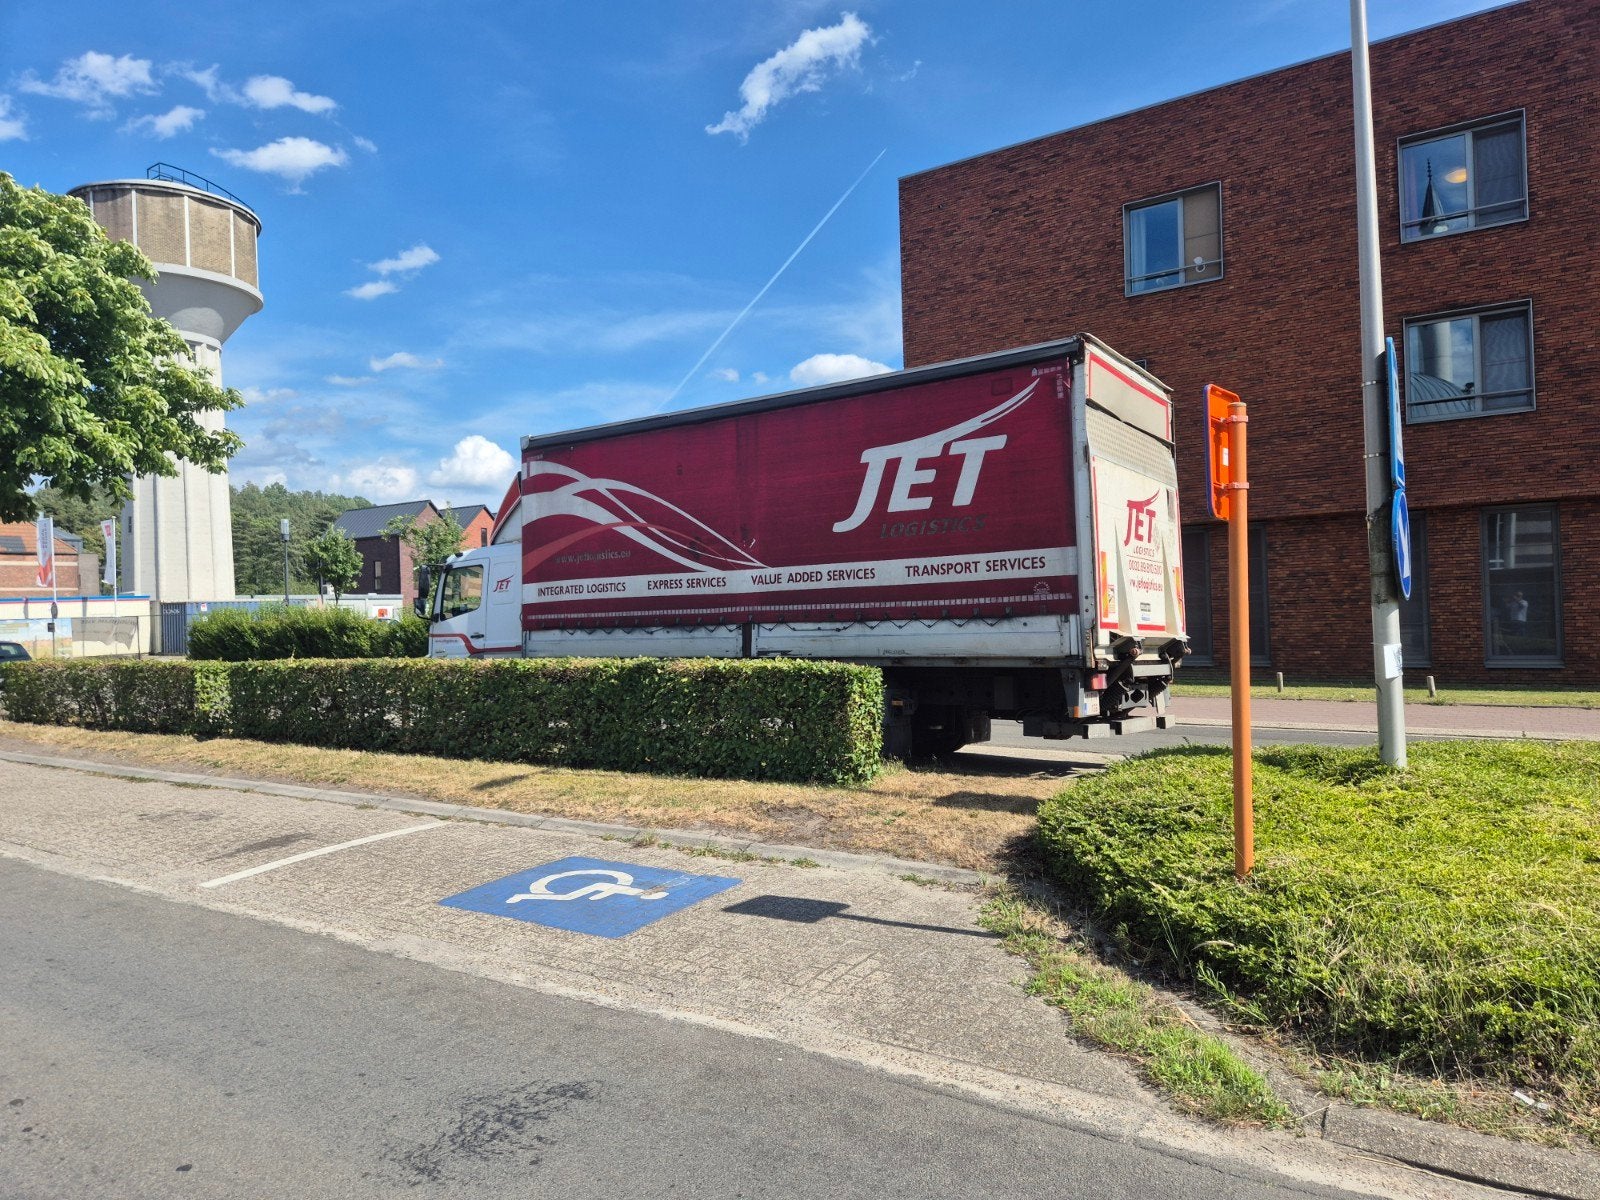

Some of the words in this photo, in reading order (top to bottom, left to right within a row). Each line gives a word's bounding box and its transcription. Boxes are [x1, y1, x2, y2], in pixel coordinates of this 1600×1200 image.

[832, 434, 1008, 533] JET
[880, 514, 988, 539] LOGISTICS
[1124, 498, 1157, 547] JET
[751, 573, 782, 586] VALUE
[787, 571, 823, 584] ADDED
[826, 568, 876, 581] SERVICES
[905, 561, 981, 578] TRANSPORT
[985, 556, 1046, 573] SERVICES
[493, 579, 512, 592] JET
[537, 584, 585, 597] INTEGRATED
[586, 582, 626, 594] LOGISTICS
[647, 579, 683, 590] EXPRESS
[686, 577, 727, 589] SERVICES
